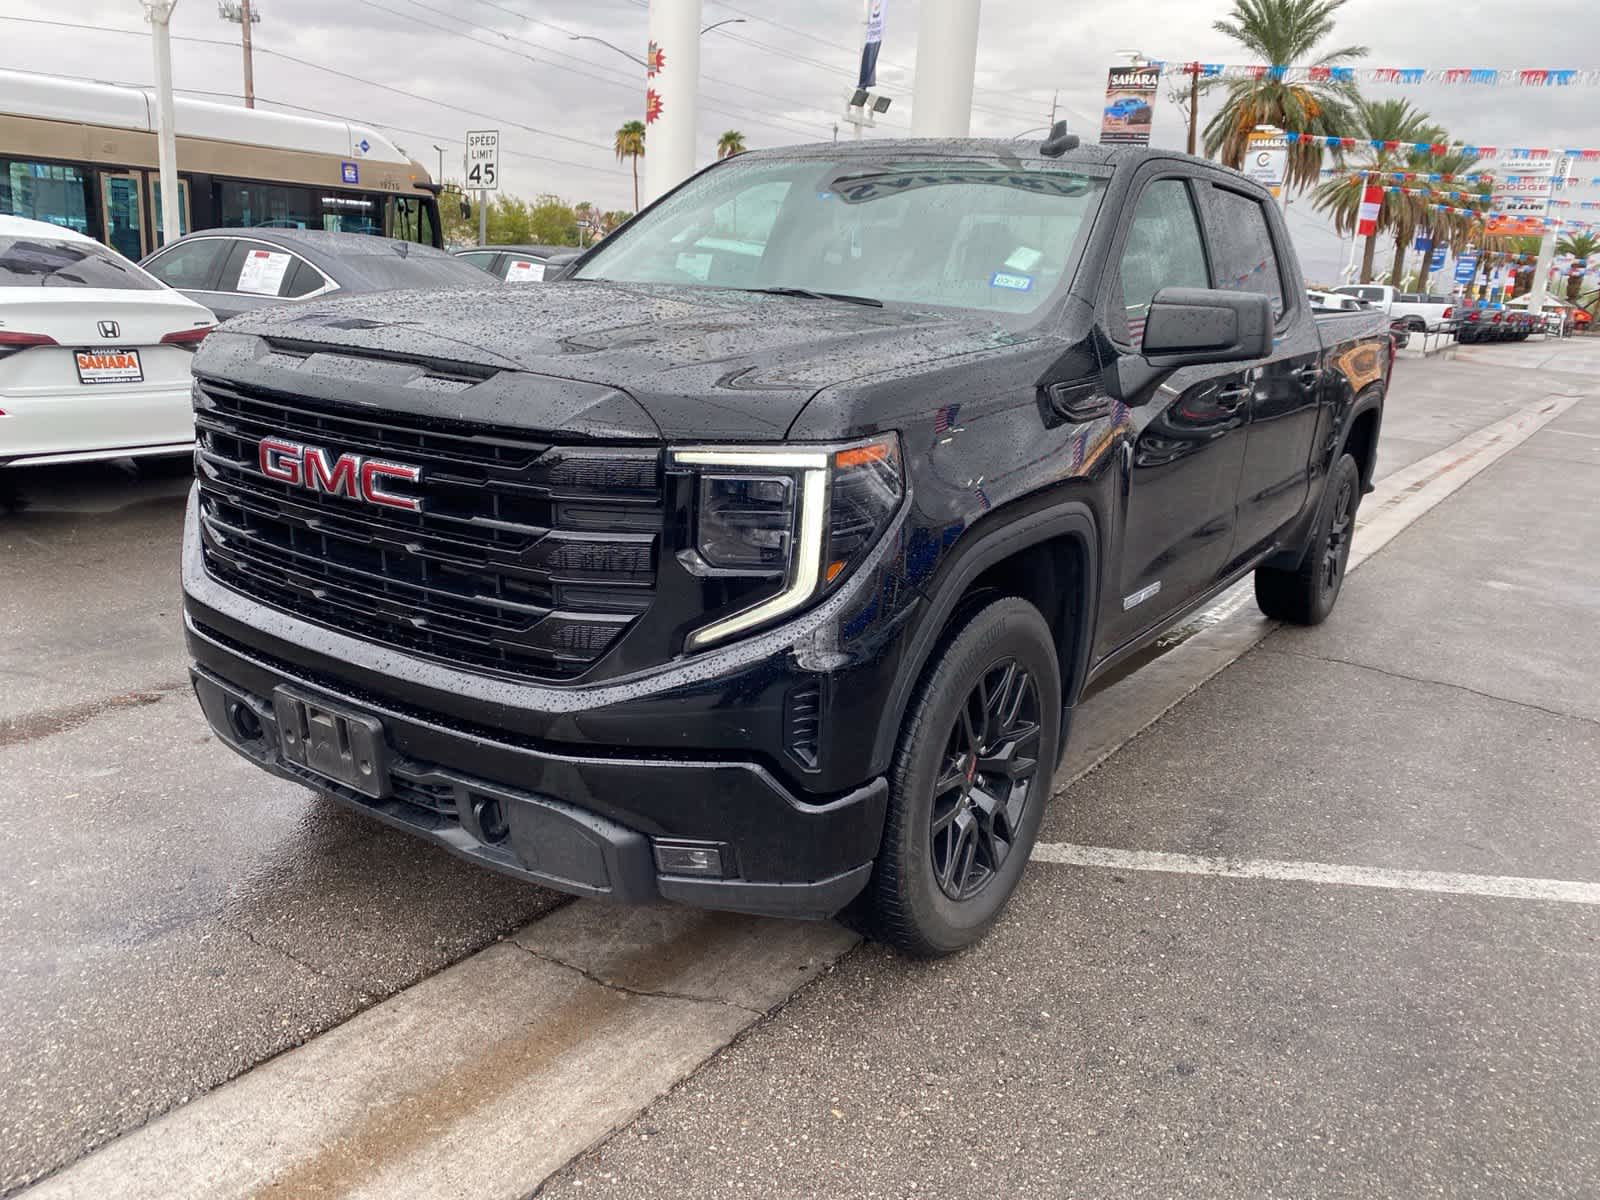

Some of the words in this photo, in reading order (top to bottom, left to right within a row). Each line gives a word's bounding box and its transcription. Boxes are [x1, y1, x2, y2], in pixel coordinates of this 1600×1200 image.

[1111, 74, 1157, 85] SAHARA
[470, 136, 497, 146] SPEED
[472, 150, 493, 159] LIMIT
[469, 163, 495, 184] 45
[78, 355, 138, 369] SAHARA
[259, 436, 423, 512] GMC
